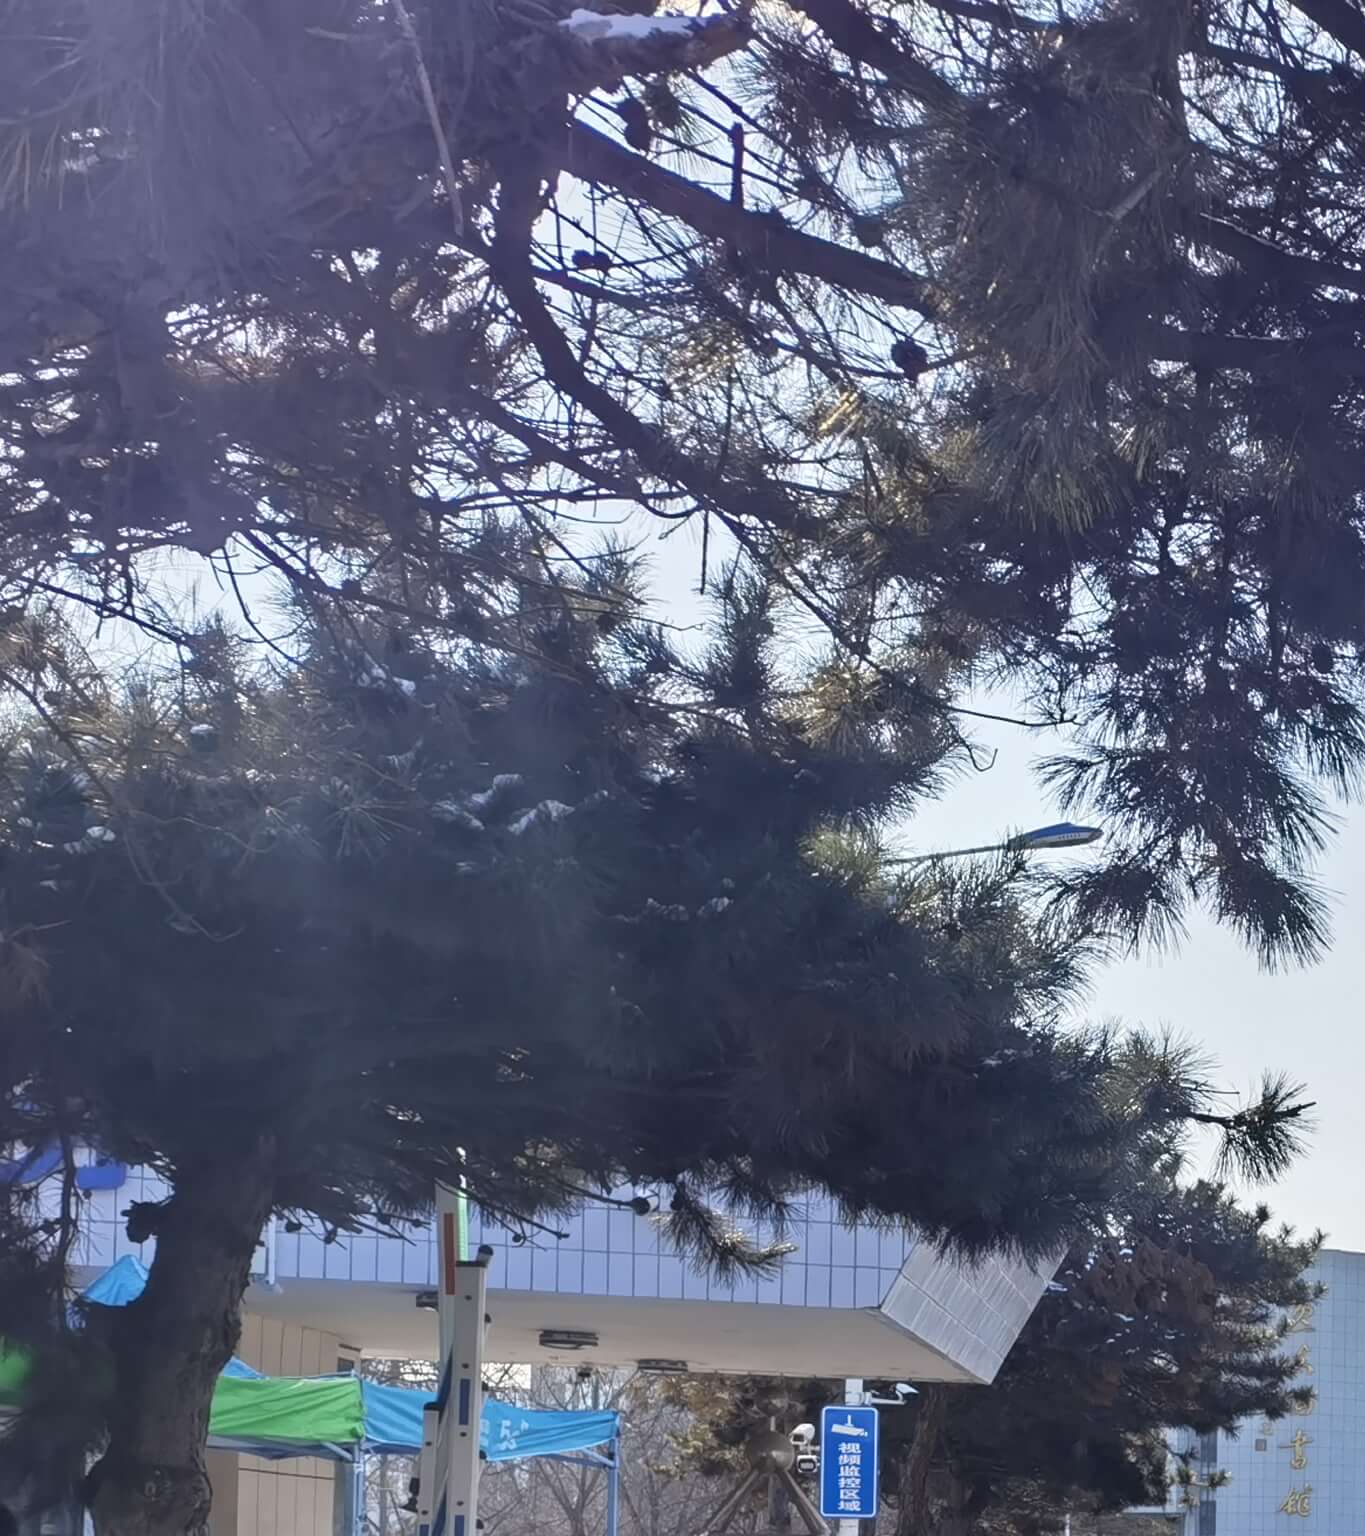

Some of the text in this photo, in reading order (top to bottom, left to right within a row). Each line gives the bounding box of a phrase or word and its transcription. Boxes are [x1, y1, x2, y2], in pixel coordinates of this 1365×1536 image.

[838, 1442, 862, 1511] 视频监控区域
